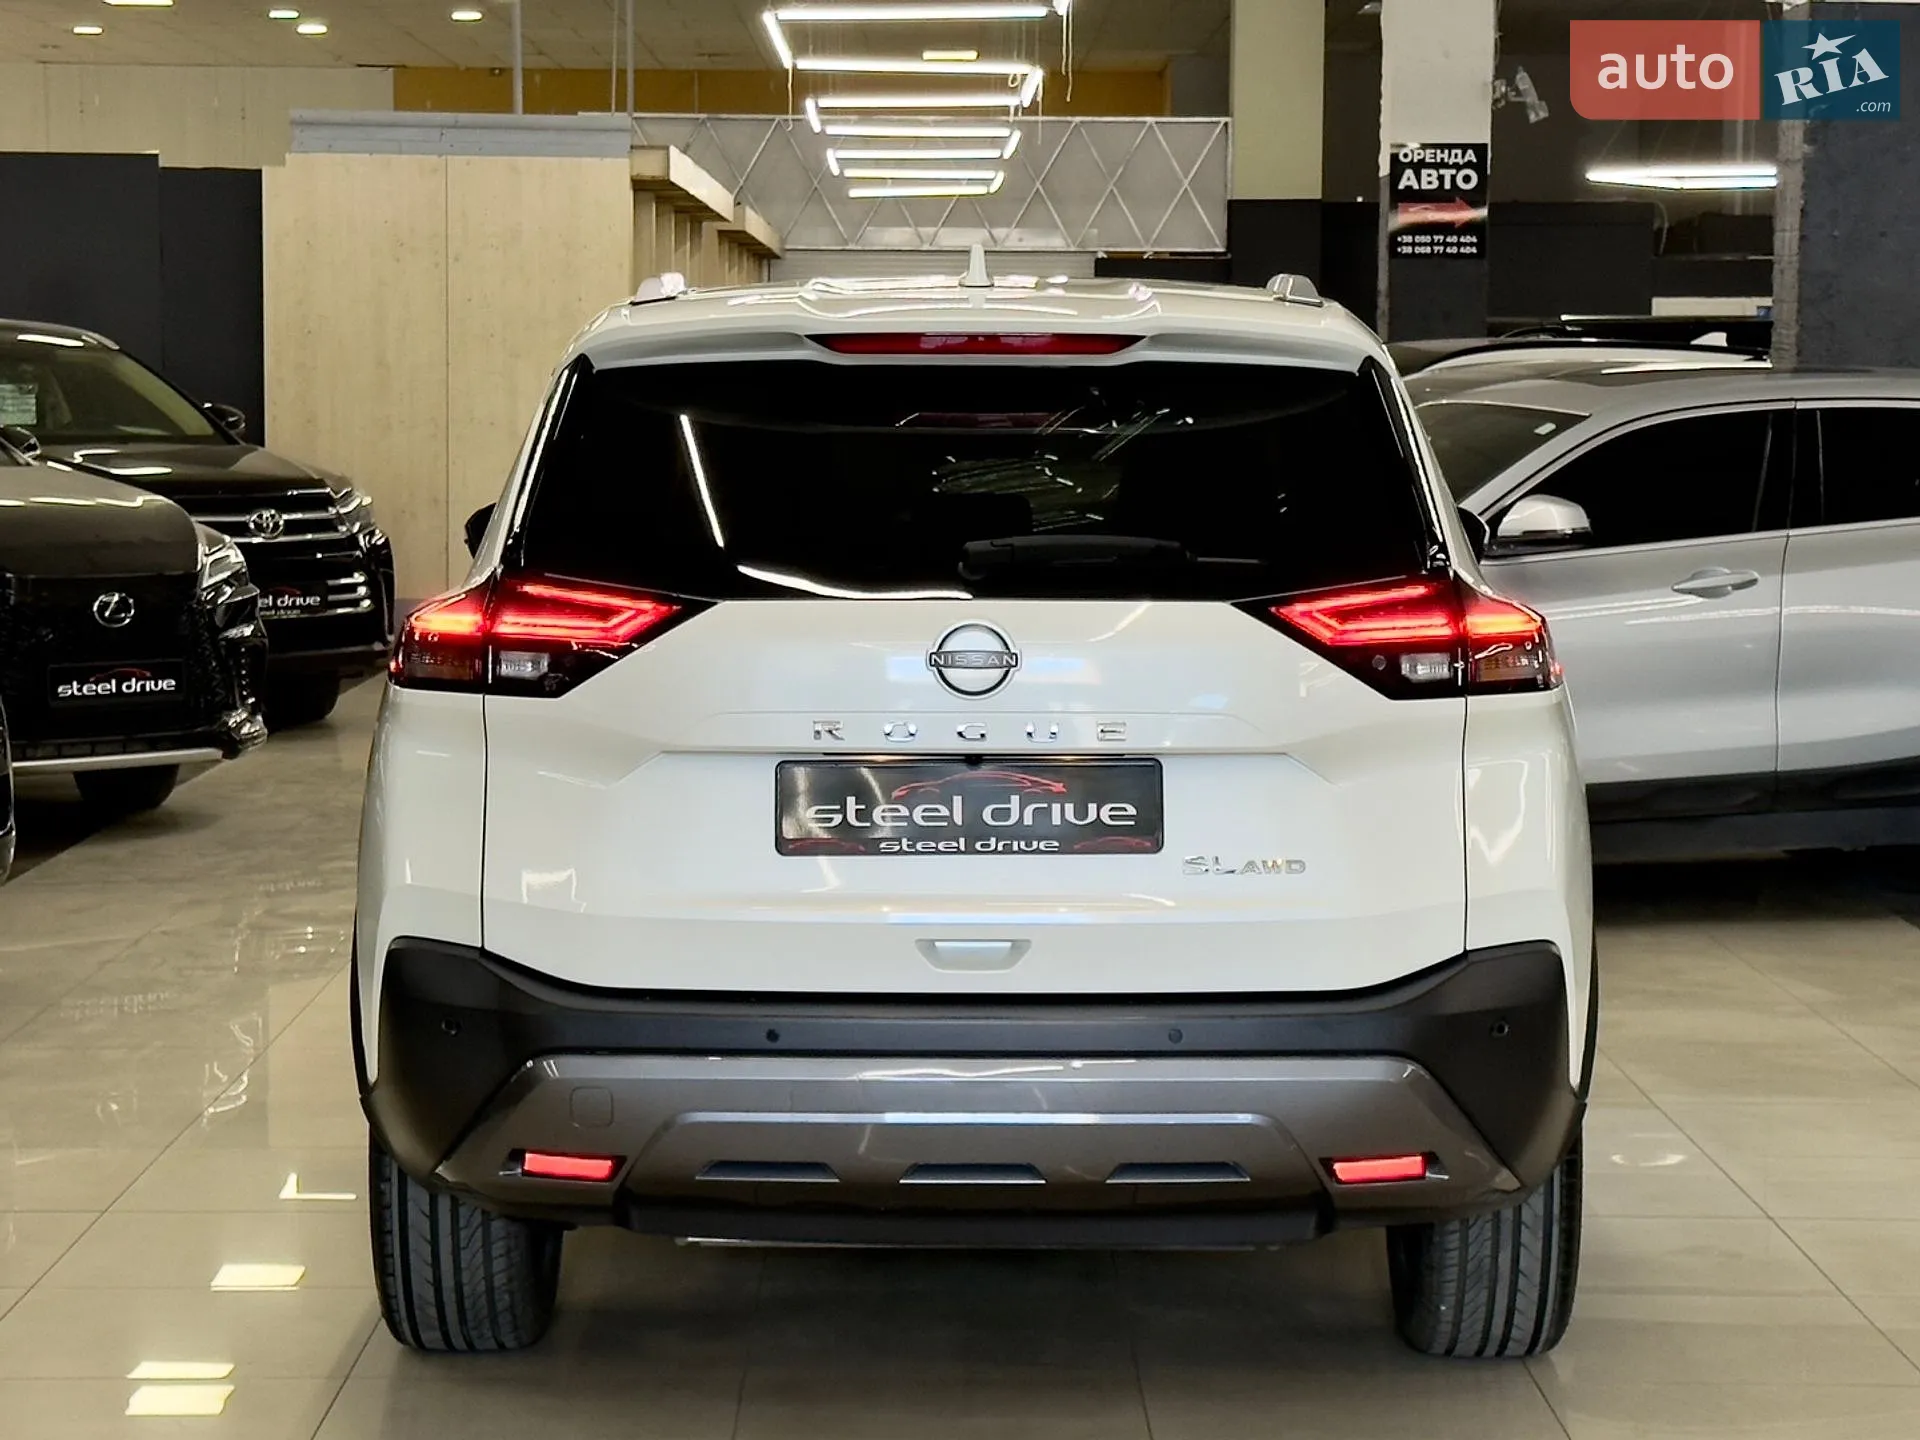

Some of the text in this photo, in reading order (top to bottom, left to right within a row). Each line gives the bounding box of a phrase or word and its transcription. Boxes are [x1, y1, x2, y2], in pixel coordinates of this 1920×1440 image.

[1398, 148, 1477, 165] ОРЕНДА
[1397, 168, 1478, 190] АВТО
[1433, 235, 1444, 243] 77
[1433, 246, 1444, 254] 77
[277, 594, 321, 607] drive
[931, 654, 1016, 666] NISSAN
[57, 677, 176, 697] steel drive
[812, 720, 1127, 742] ROGUE
[806, 794, 1137, 827] steel drive
[879, 837, 1060, 852] steel drive
[1239, 859, 1307, 875] AWD
